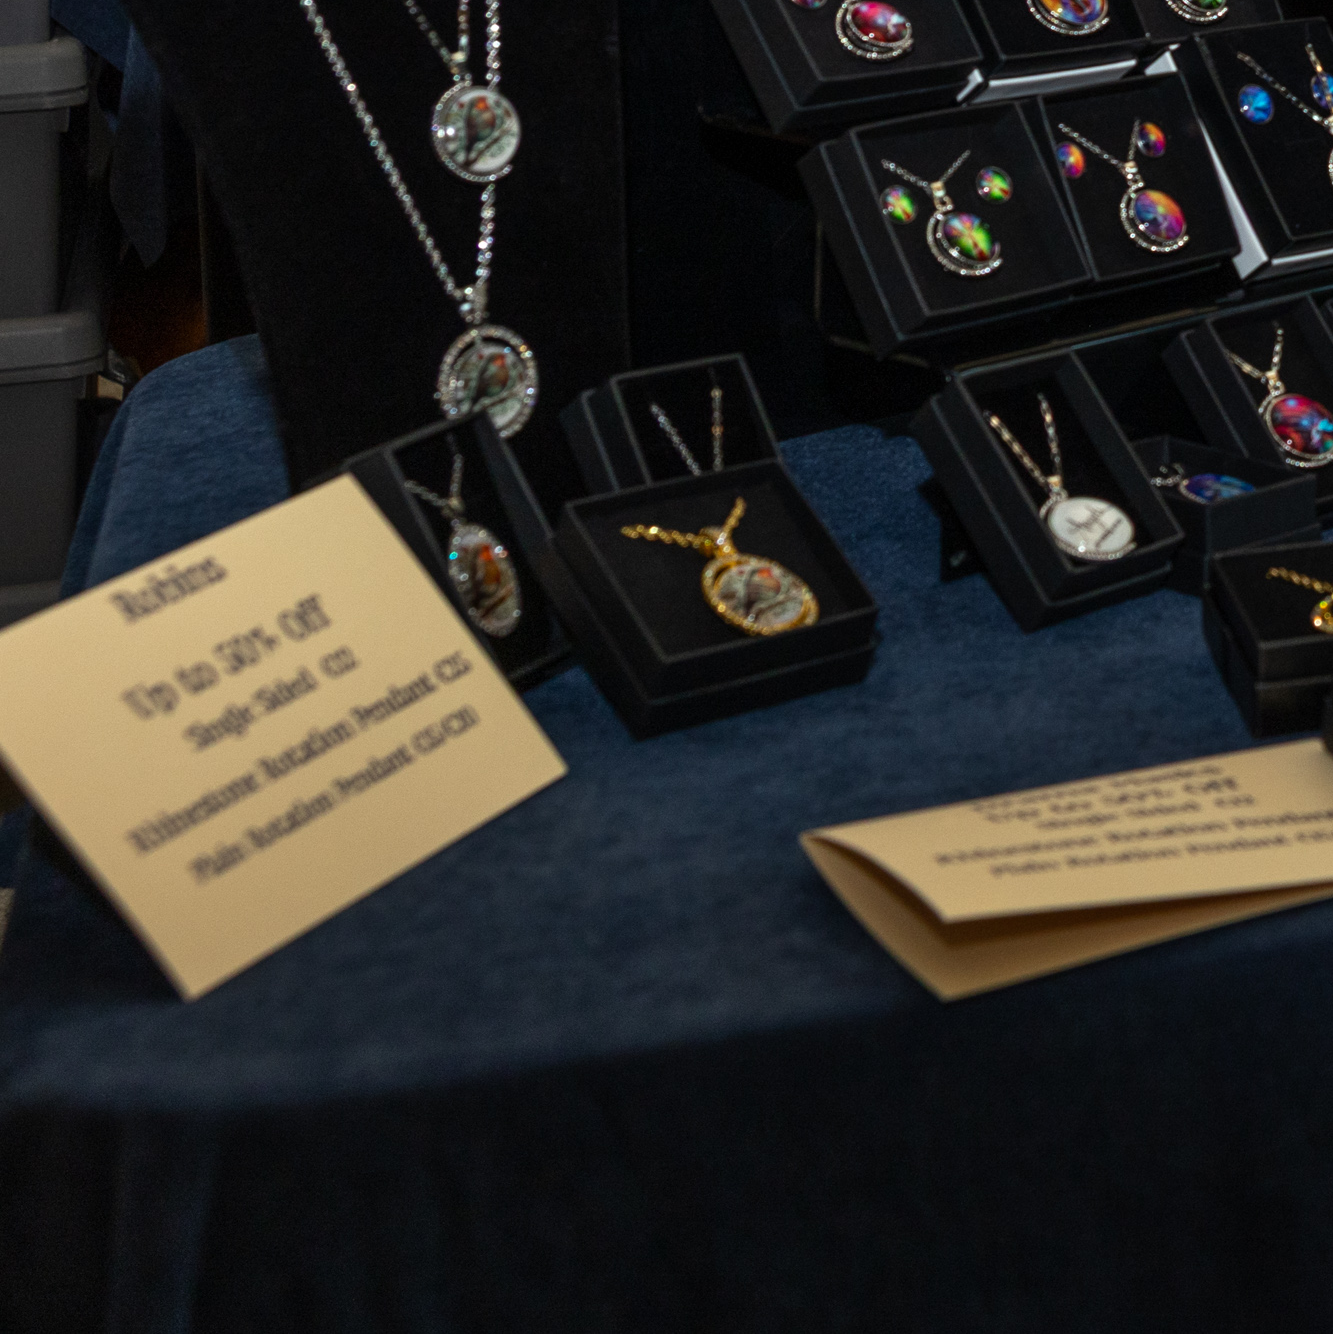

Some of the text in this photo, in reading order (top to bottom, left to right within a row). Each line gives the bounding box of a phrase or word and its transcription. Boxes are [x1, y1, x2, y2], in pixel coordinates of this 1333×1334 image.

[122, 682, 181, 720] Up
[175, 662, 220, 695] to
[278, 593, 332, 642] Off
